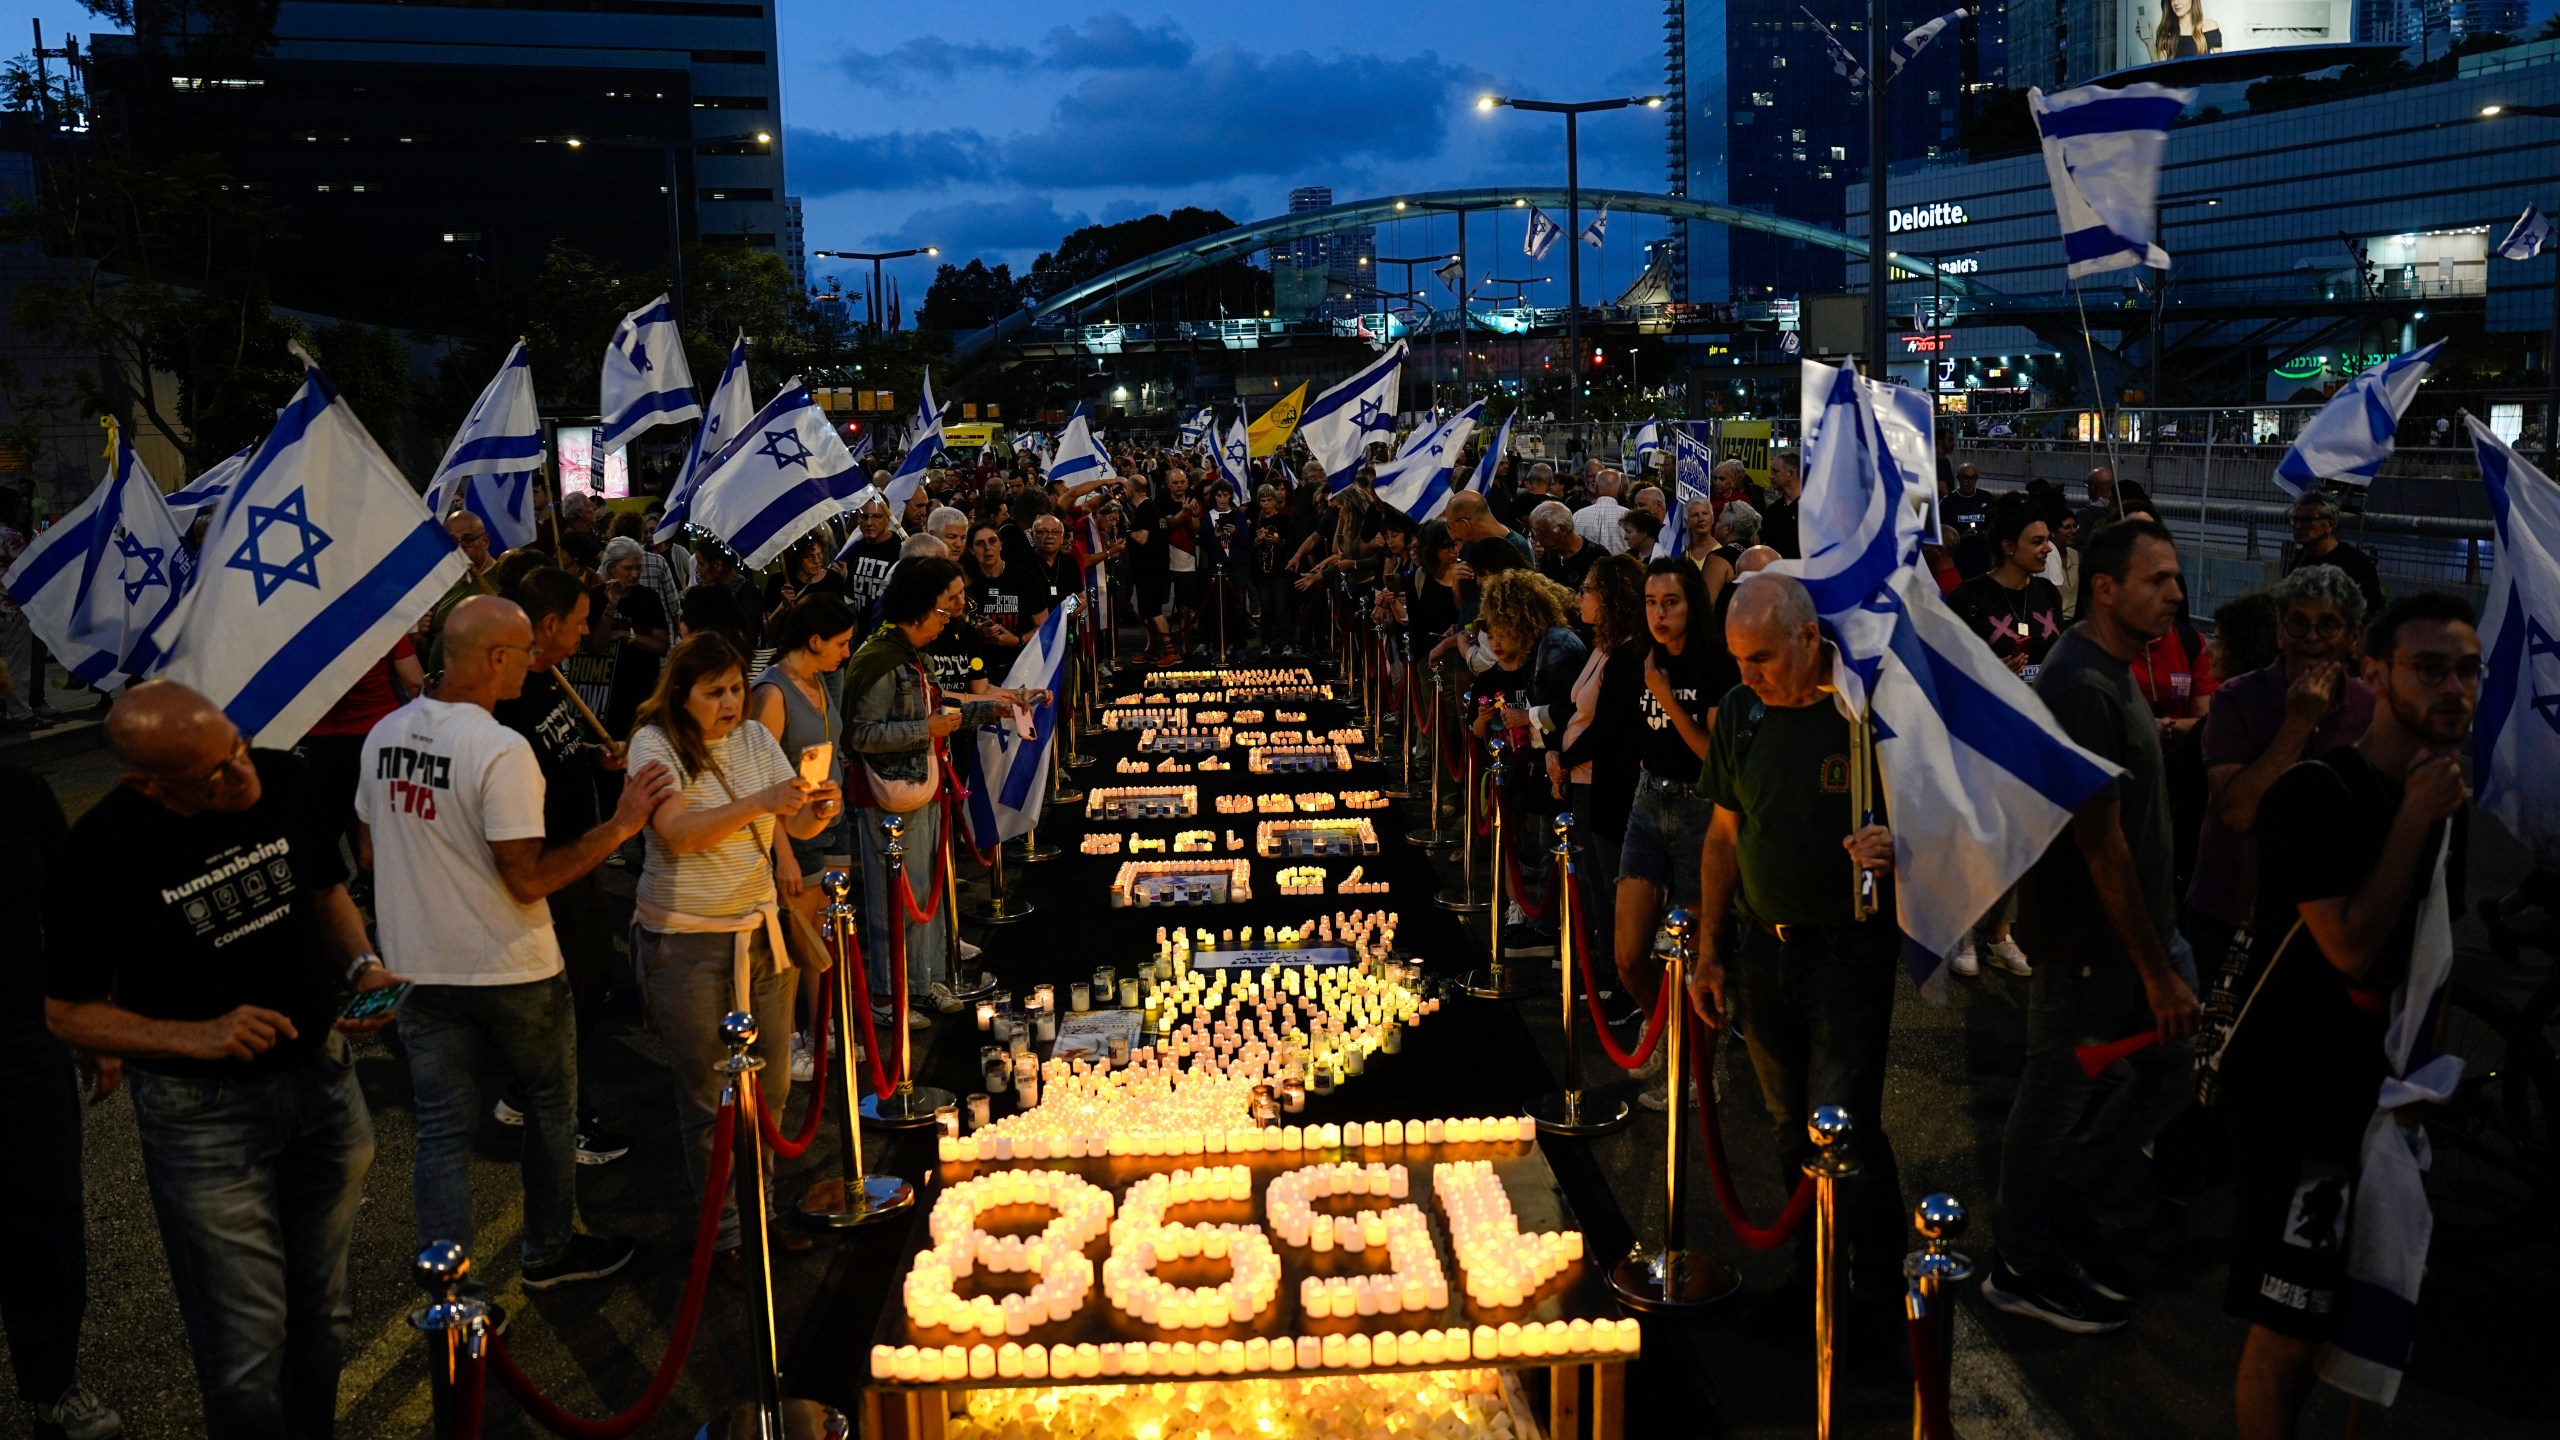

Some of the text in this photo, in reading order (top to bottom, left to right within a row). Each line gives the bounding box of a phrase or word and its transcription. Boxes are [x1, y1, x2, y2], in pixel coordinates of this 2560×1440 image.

[570, 656, 615, 684] HOME
[377, 746, 451, 790] בחירות
[160, 836, 291, 905] humanbeing
[213, 902, 292, 949] COMMUNITY
